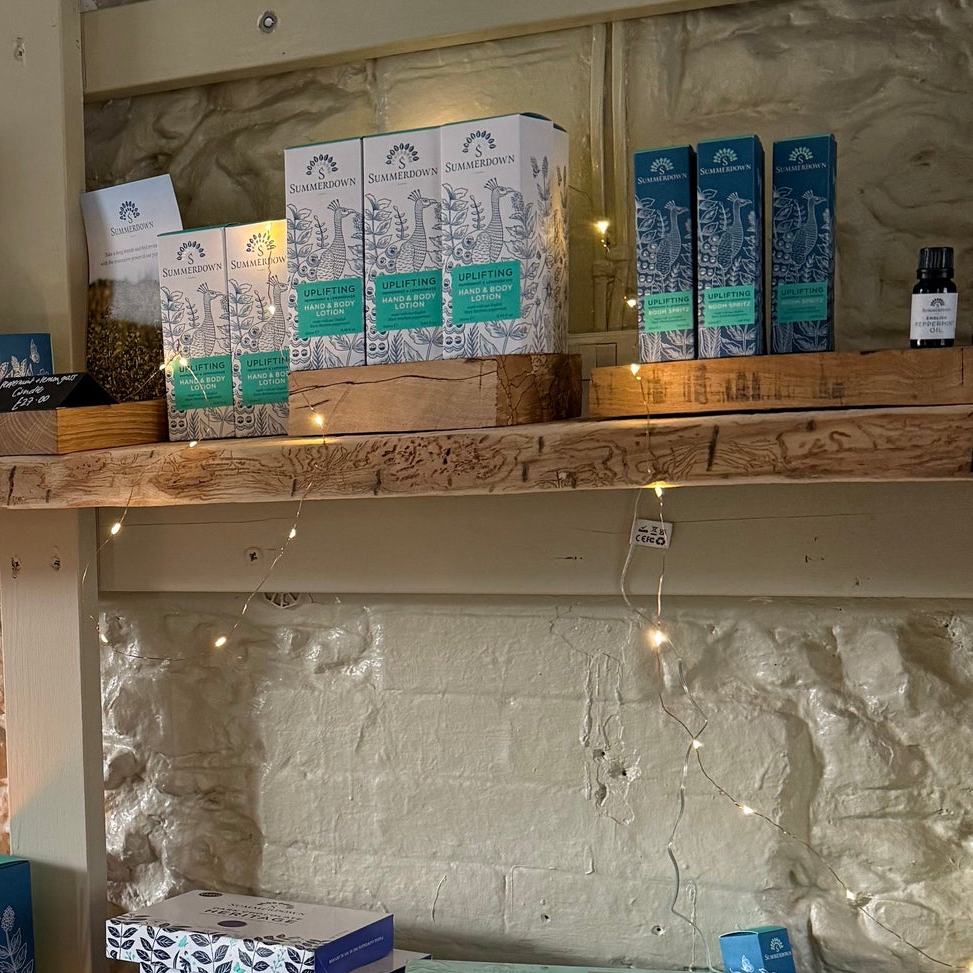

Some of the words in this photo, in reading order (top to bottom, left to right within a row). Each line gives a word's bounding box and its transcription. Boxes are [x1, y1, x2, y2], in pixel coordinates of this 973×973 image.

[444, 154, 515, 174] SUMMERDOWN
[699, 163, 752, 176] SUMMERDOWN
[368, 167, 439, 184] SUMMERDOWN
[637, 172, 687, 185] SUMMERDOWN
[289, 177, 356, 194] SUMMERDOWN
[110, 221, 154, 236] SUMMERDOWN
[162, 263, 223, 278] SUMMERDOWN
[459, 268, 513, 281] UPLIFTING
[382, 277, 436, 290] UPLIFTING
[303, 284, 355, 298] UPLIFTING
[458, 287, 480, 296] HAND
[482, 286, 489, 294] &
[489, 284, 513, 293] BODY
[708, 291, 751, 300] UPLIFTING
[781, 287, 824, 296] UPLIFTING
[382, 295, 404, 304] HAND
[406, 294, 412, 302] &
[413, 292, 436, 301] BODY
[470, 293, 502, 302] LOTION
[647, 296, 689, 306] UPLIFTING
[304, 302, 326, 310] HAND
[326, 301, 332, 309] &
[333, 300, 355, 308] BODY
[394, 301, 425, 310] LOTION
[315, 308, 345, 317] LOTION
[179, 361, 225, 373] UPLIFTING
[247, 357, 287, 368] UPLIFTIN
[259, 378, 286, 386] LOTION
[11, 386, 45, 398] Candle
[11, 394, 51, 411] £27.00
